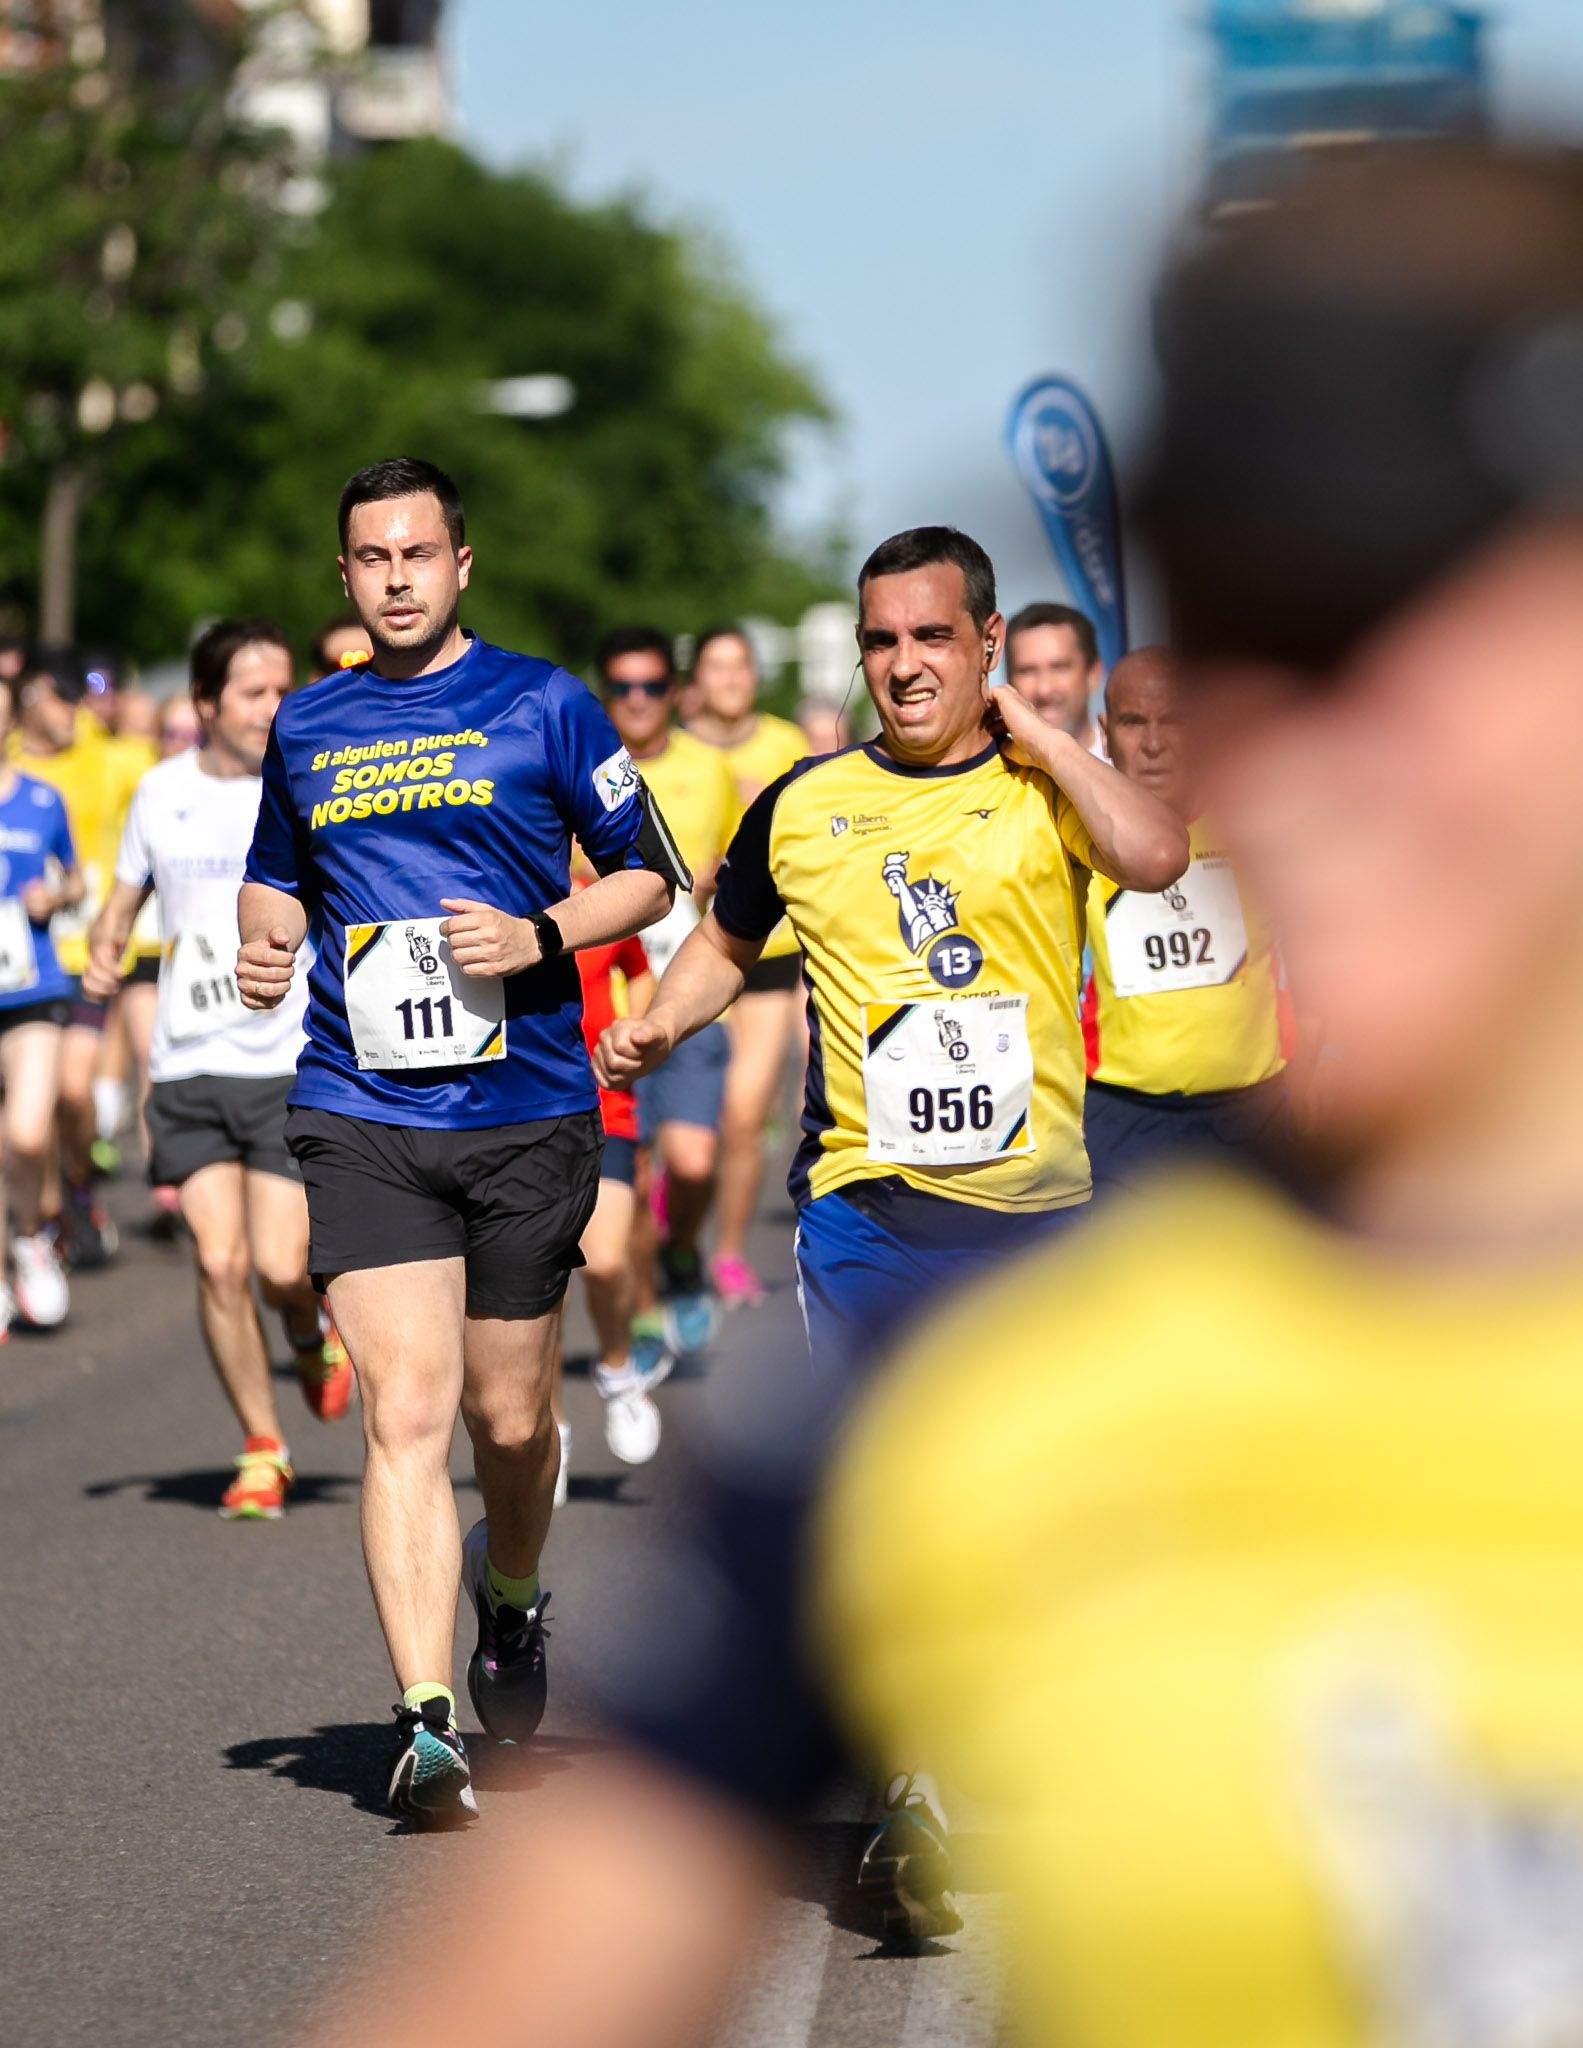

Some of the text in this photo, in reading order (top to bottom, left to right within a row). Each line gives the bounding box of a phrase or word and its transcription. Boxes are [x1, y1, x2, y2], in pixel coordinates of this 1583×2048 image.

[311, 728, 489, 771] Si alguien puede,
[331, 752, 456, 794] SOMOS
[311, 779, 495, 831] NOSOTROS
[421, 959, 435, 971] 13
[937, 947, 972, 977] 13
[1145, 928, 1215, 970] 992
[395, 995, 454, 1040] 111
[909, 1084, 994, 1134] 956
